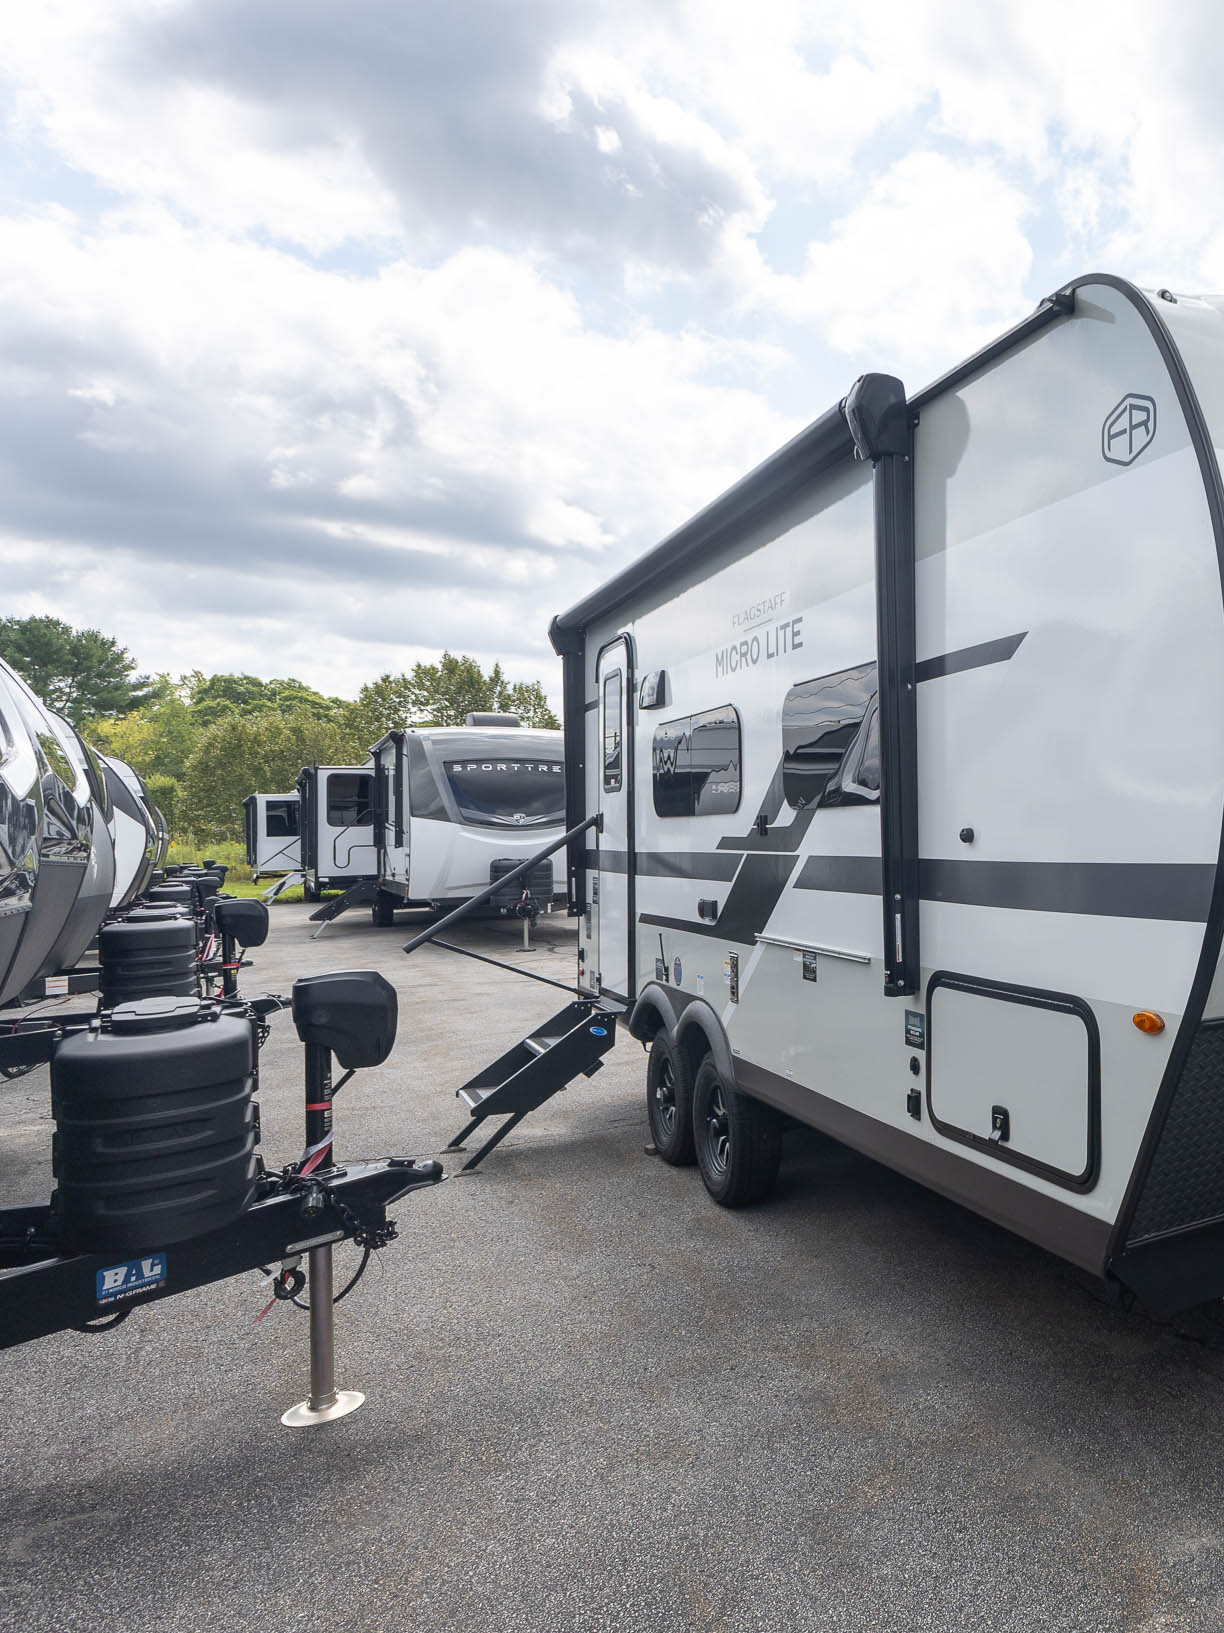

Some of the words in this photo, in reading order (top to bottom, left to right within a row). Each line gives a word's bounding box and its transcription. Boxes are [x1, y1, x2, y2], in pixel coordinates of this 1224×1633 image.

[731, 591, 787, 628] FLAGSTAFF
[715, 635, 761, 679] MICRO
[766, 616, 804, 660] LITE
[102, 1258, 162, 1291] BAL
